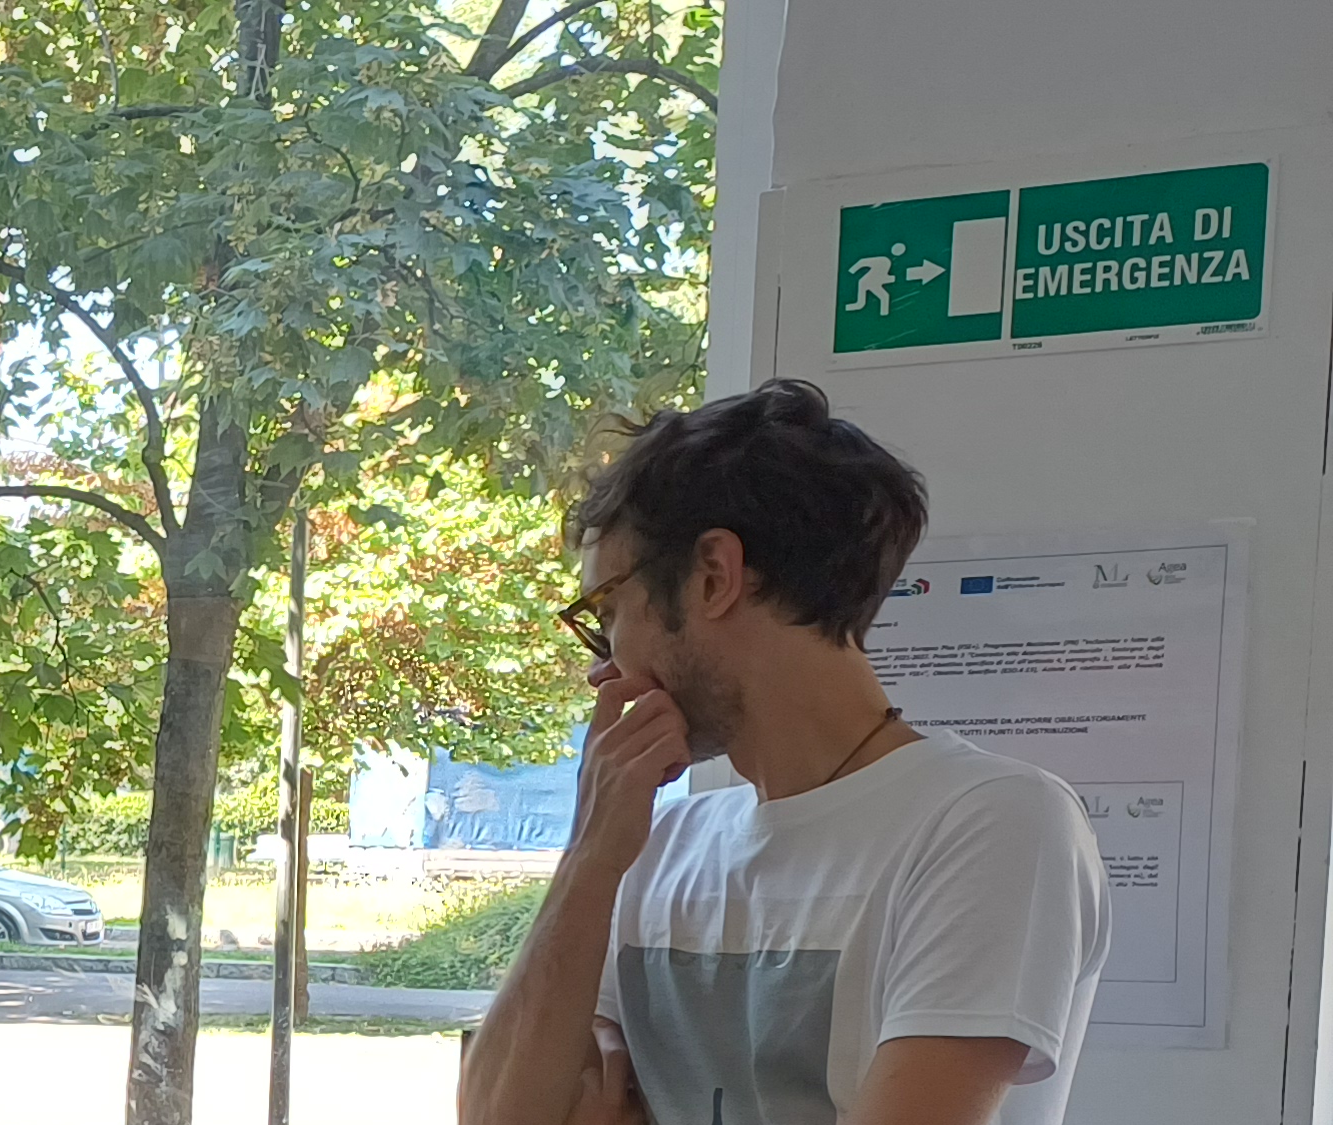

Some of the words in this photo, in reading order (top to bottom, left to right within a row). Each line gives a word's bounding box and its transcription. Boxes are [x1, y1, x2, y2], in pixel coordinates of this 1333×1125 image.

[1036, 212, 1174, 257] USCITA
[1193, 206, 1233, 242] DI
[1014, 248, 1251, 301] EMERGENZA
[907, 719, 929, 729] STER
